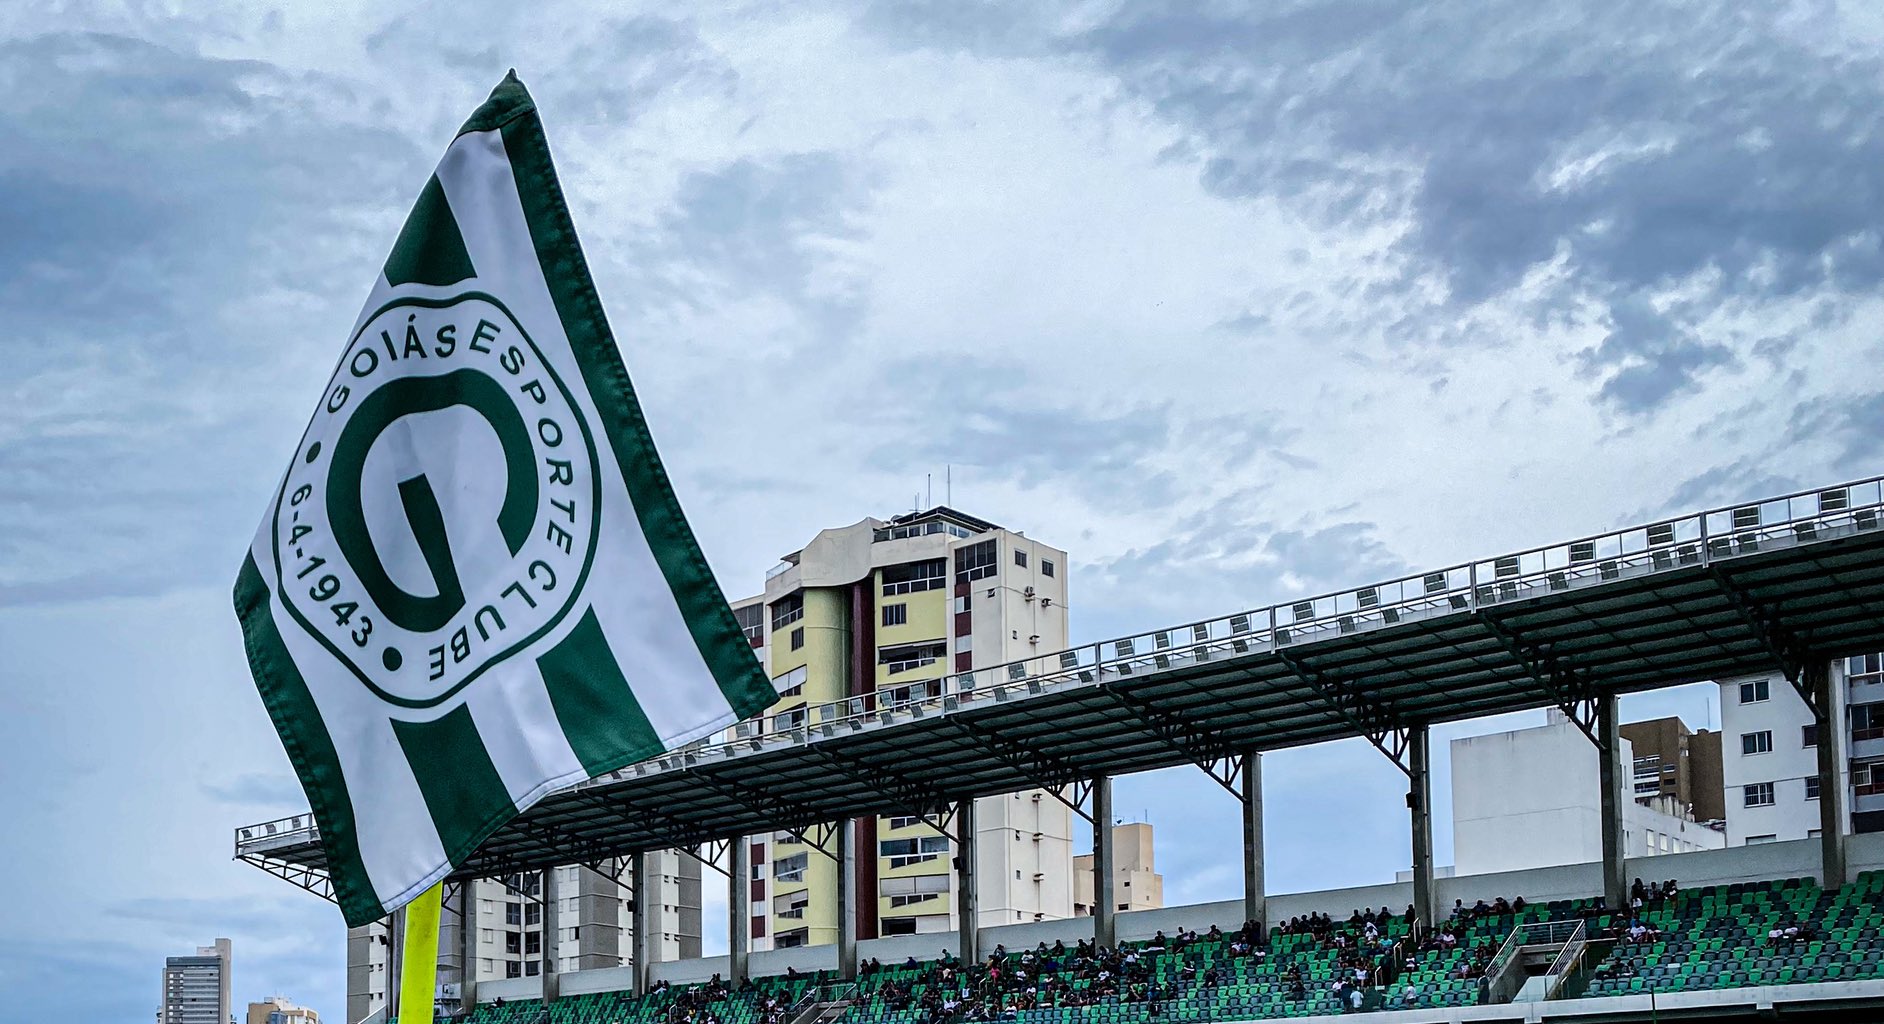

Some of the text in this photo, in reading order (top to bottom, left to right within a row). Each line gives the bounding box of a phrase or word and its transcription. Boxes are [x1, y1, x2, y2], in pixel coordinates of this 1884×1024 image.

[287, 482, 375, 648] 6-4-1943
[327, 313, 576, 681] GOIÁS ESPORTE CLUBE
